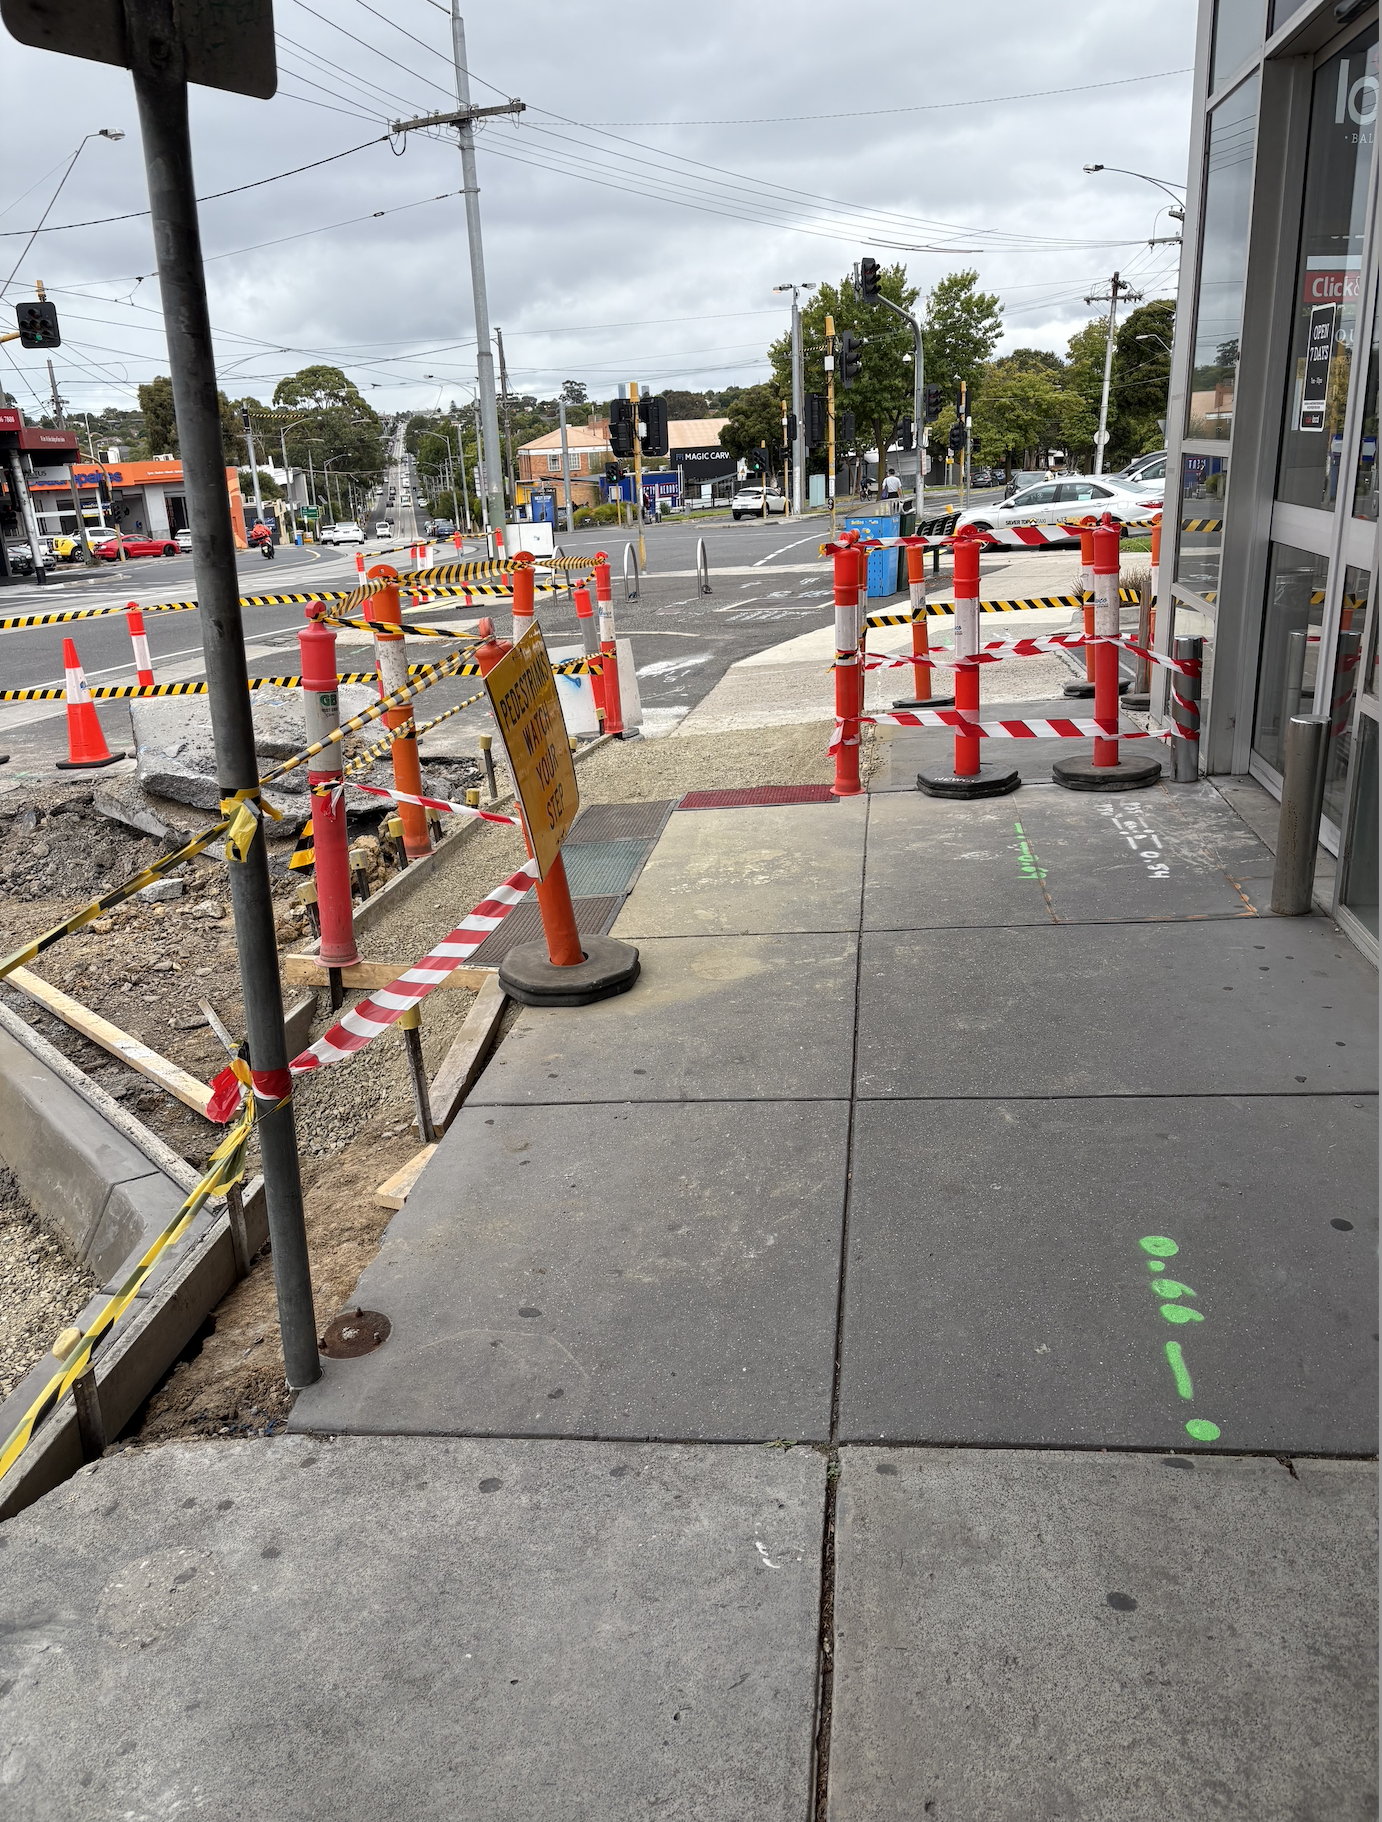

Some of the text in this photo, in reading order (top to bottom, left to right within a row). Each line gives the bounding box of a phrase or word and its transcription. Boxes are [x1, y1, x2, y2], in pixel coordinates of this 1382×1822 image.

[1313, 323, 1329, 340] OPEN
[1314, 345, 1329, 361] DAYS
[685, 452, 710, 461] MAGIC
[499, 650, 550, 732] PEDESTRIANS
[522, 699, 552, 757] WATCH
[536, 743, 560, 792] YOUR
[546, 783, 565, 831] STEP
